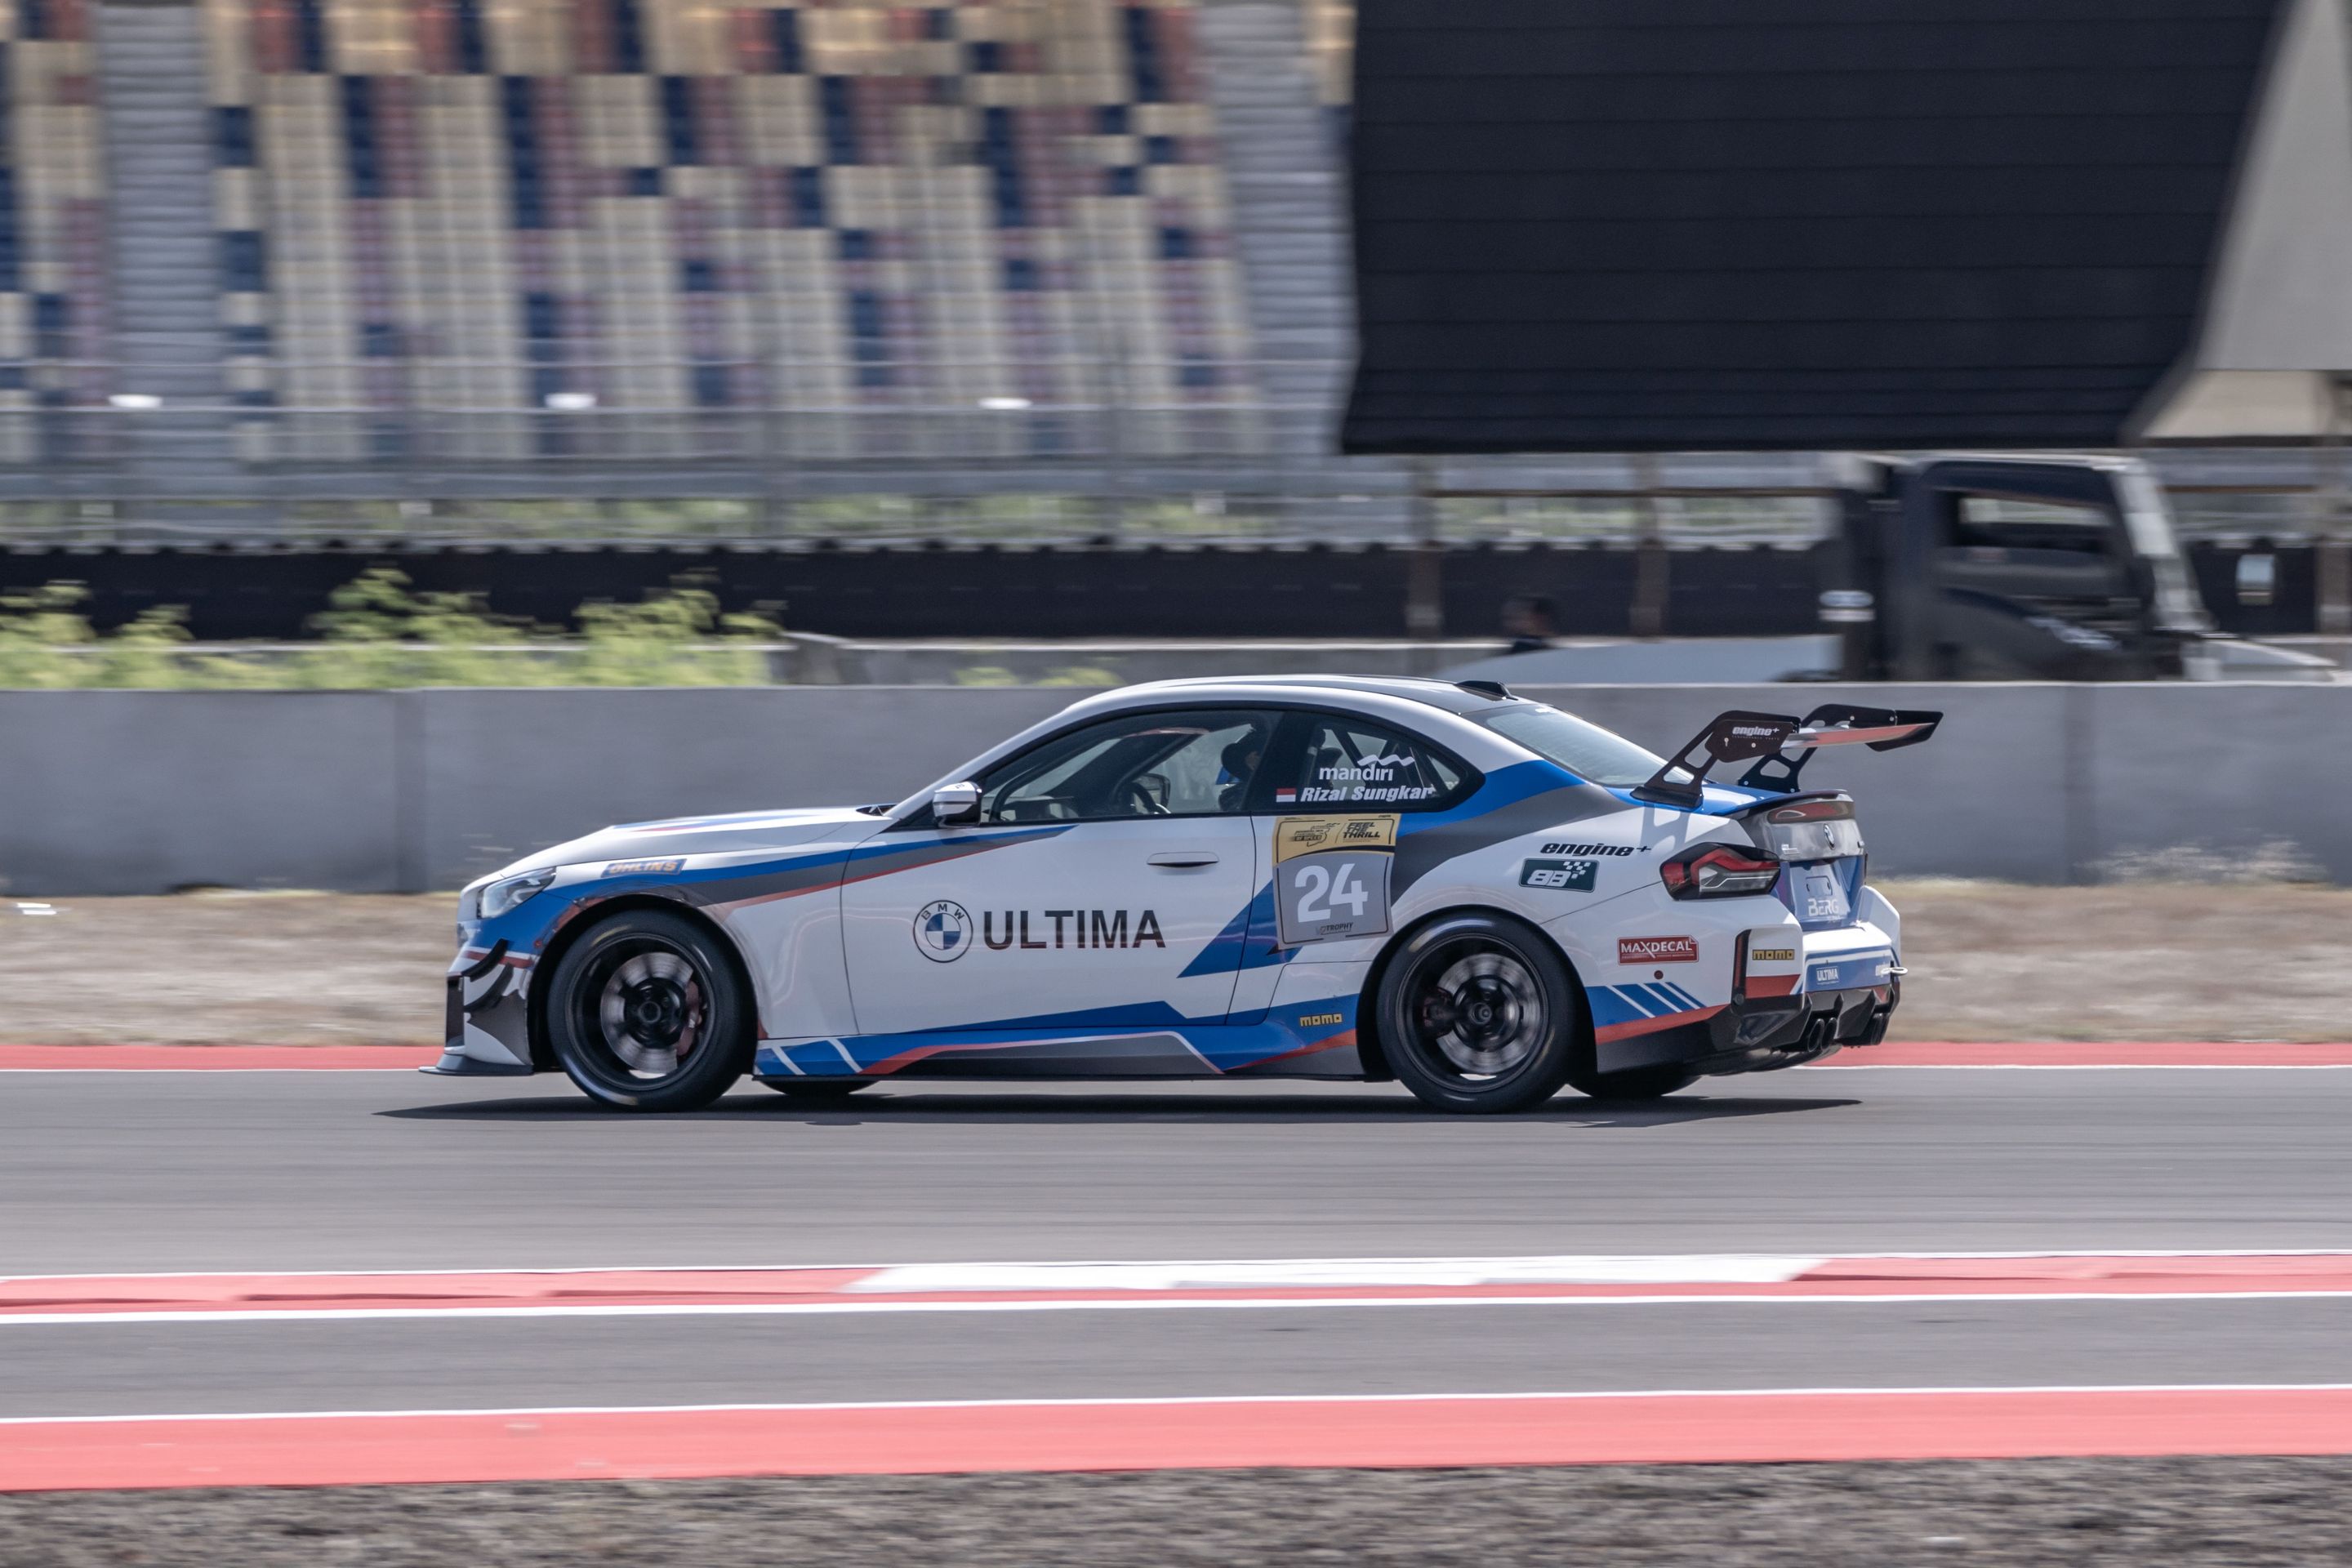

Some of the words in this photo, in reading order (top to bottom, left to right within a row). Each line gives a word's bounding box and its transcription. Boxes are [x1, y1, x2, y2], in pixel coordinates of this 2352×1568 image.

[1319, 764, 1393, 782] mandiri
[1300, 786, 1347, 802] Rizal
[1351, 786, 1432, 802] Sungkar
[1540, 843, 1651, 857] engine+
[1294, 863, 1369, 923] 24
[920, 903, 965, 920] BMW
[983, 910, 1166, 950] ULTIMA
[1325, 922, 1353, 931] TROPHY
[1620, 941, 1693, 958] MAXDECAL
[1816, 968, 1839, 982] ULTIMA
